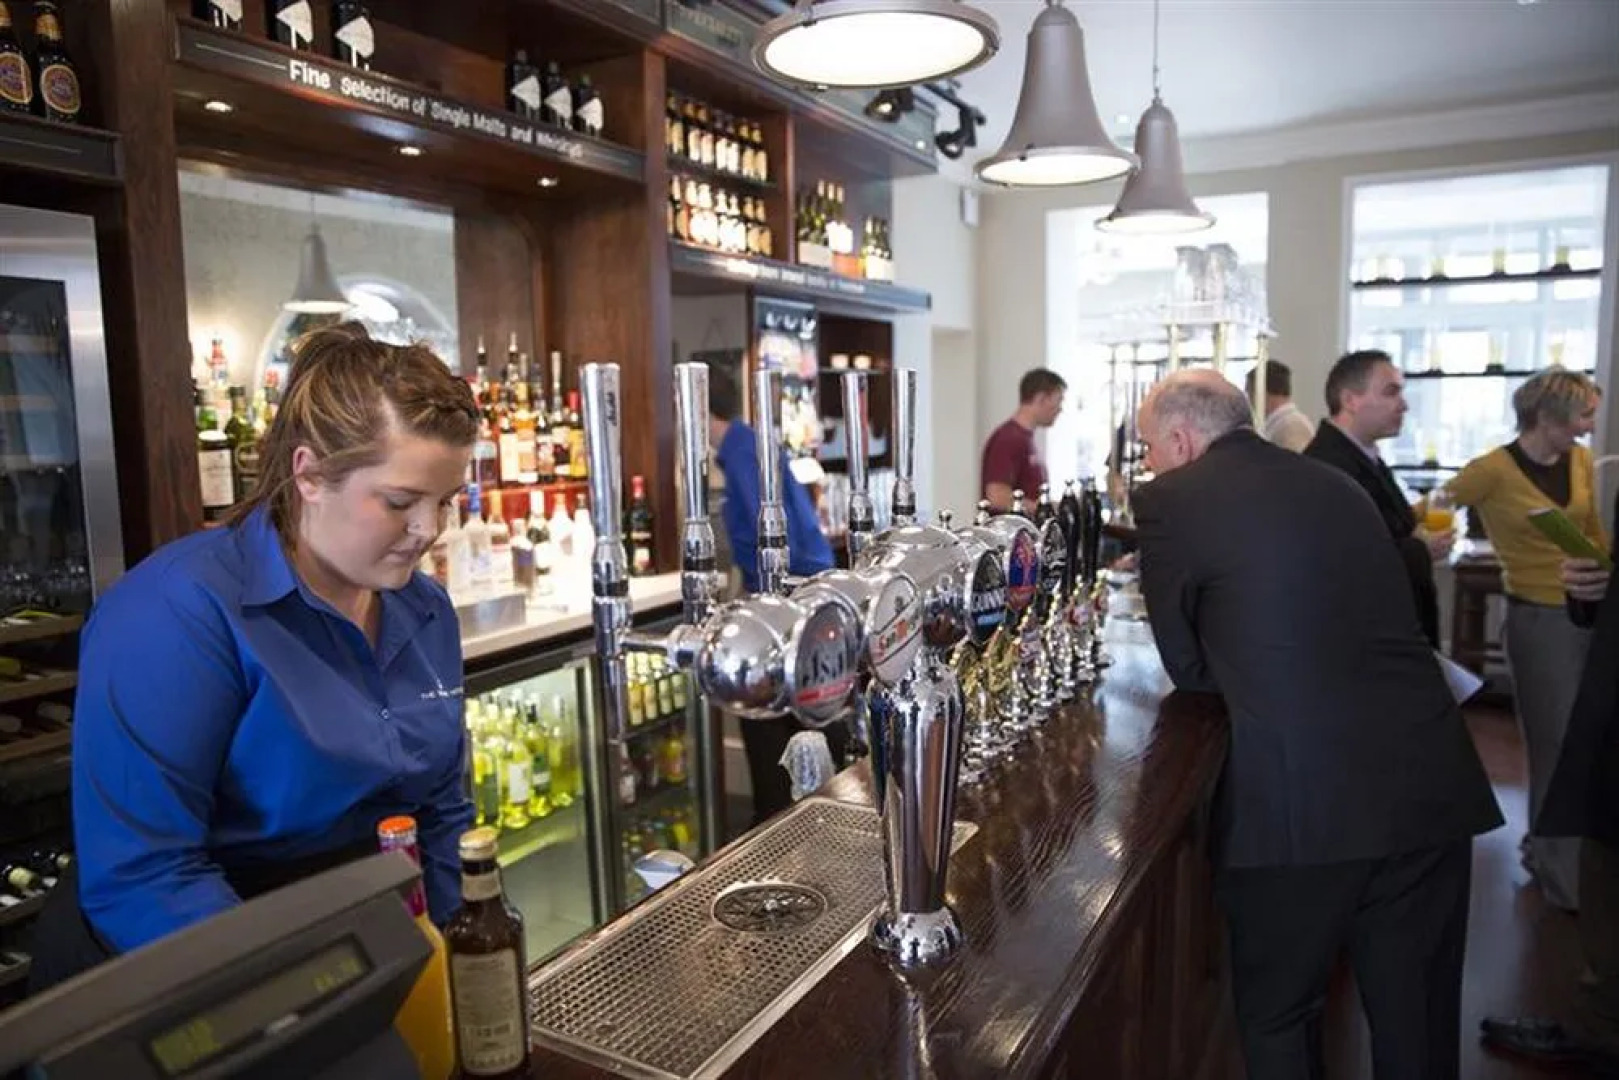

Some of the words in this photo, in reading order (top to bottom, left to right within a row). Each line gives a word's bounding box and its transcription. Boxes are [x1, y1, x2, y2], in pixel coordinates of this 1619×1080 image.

[289, 59, 331, 90] Fine
[339, 76, 410, 111] Selection
[412, 96, 425, 117] of
[430, 101, 471, 129] Single
[473, 112, 507, 138] Malts
[510, 126, 533, 144] and
